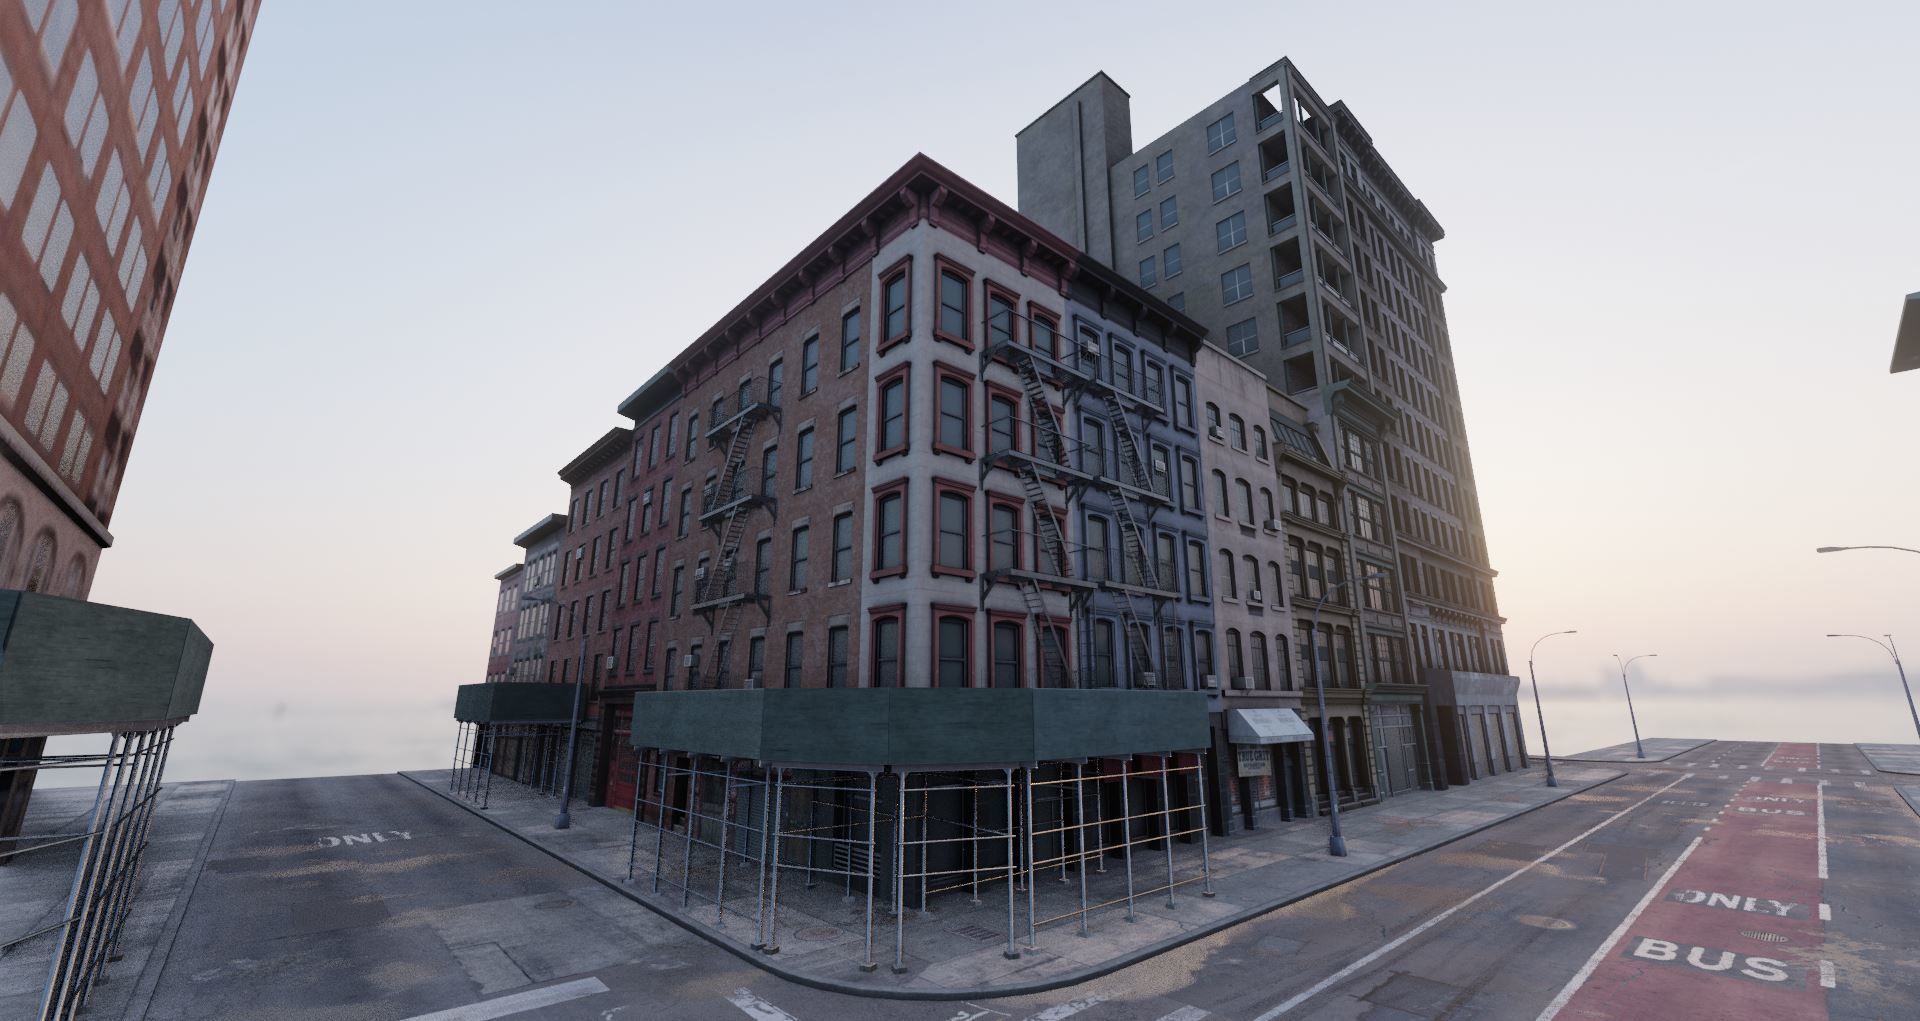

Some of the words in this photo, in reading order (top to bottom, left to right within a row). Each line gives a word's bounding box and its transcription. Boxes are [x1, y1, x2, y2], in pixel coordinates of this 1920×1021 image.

[1738, 806, 1805, 816] BUS
[316, 831, 411, 848] ONLY
[1675, 889, 1798, 917] ONLY
[1634, 937, 1789, 982] BUS
